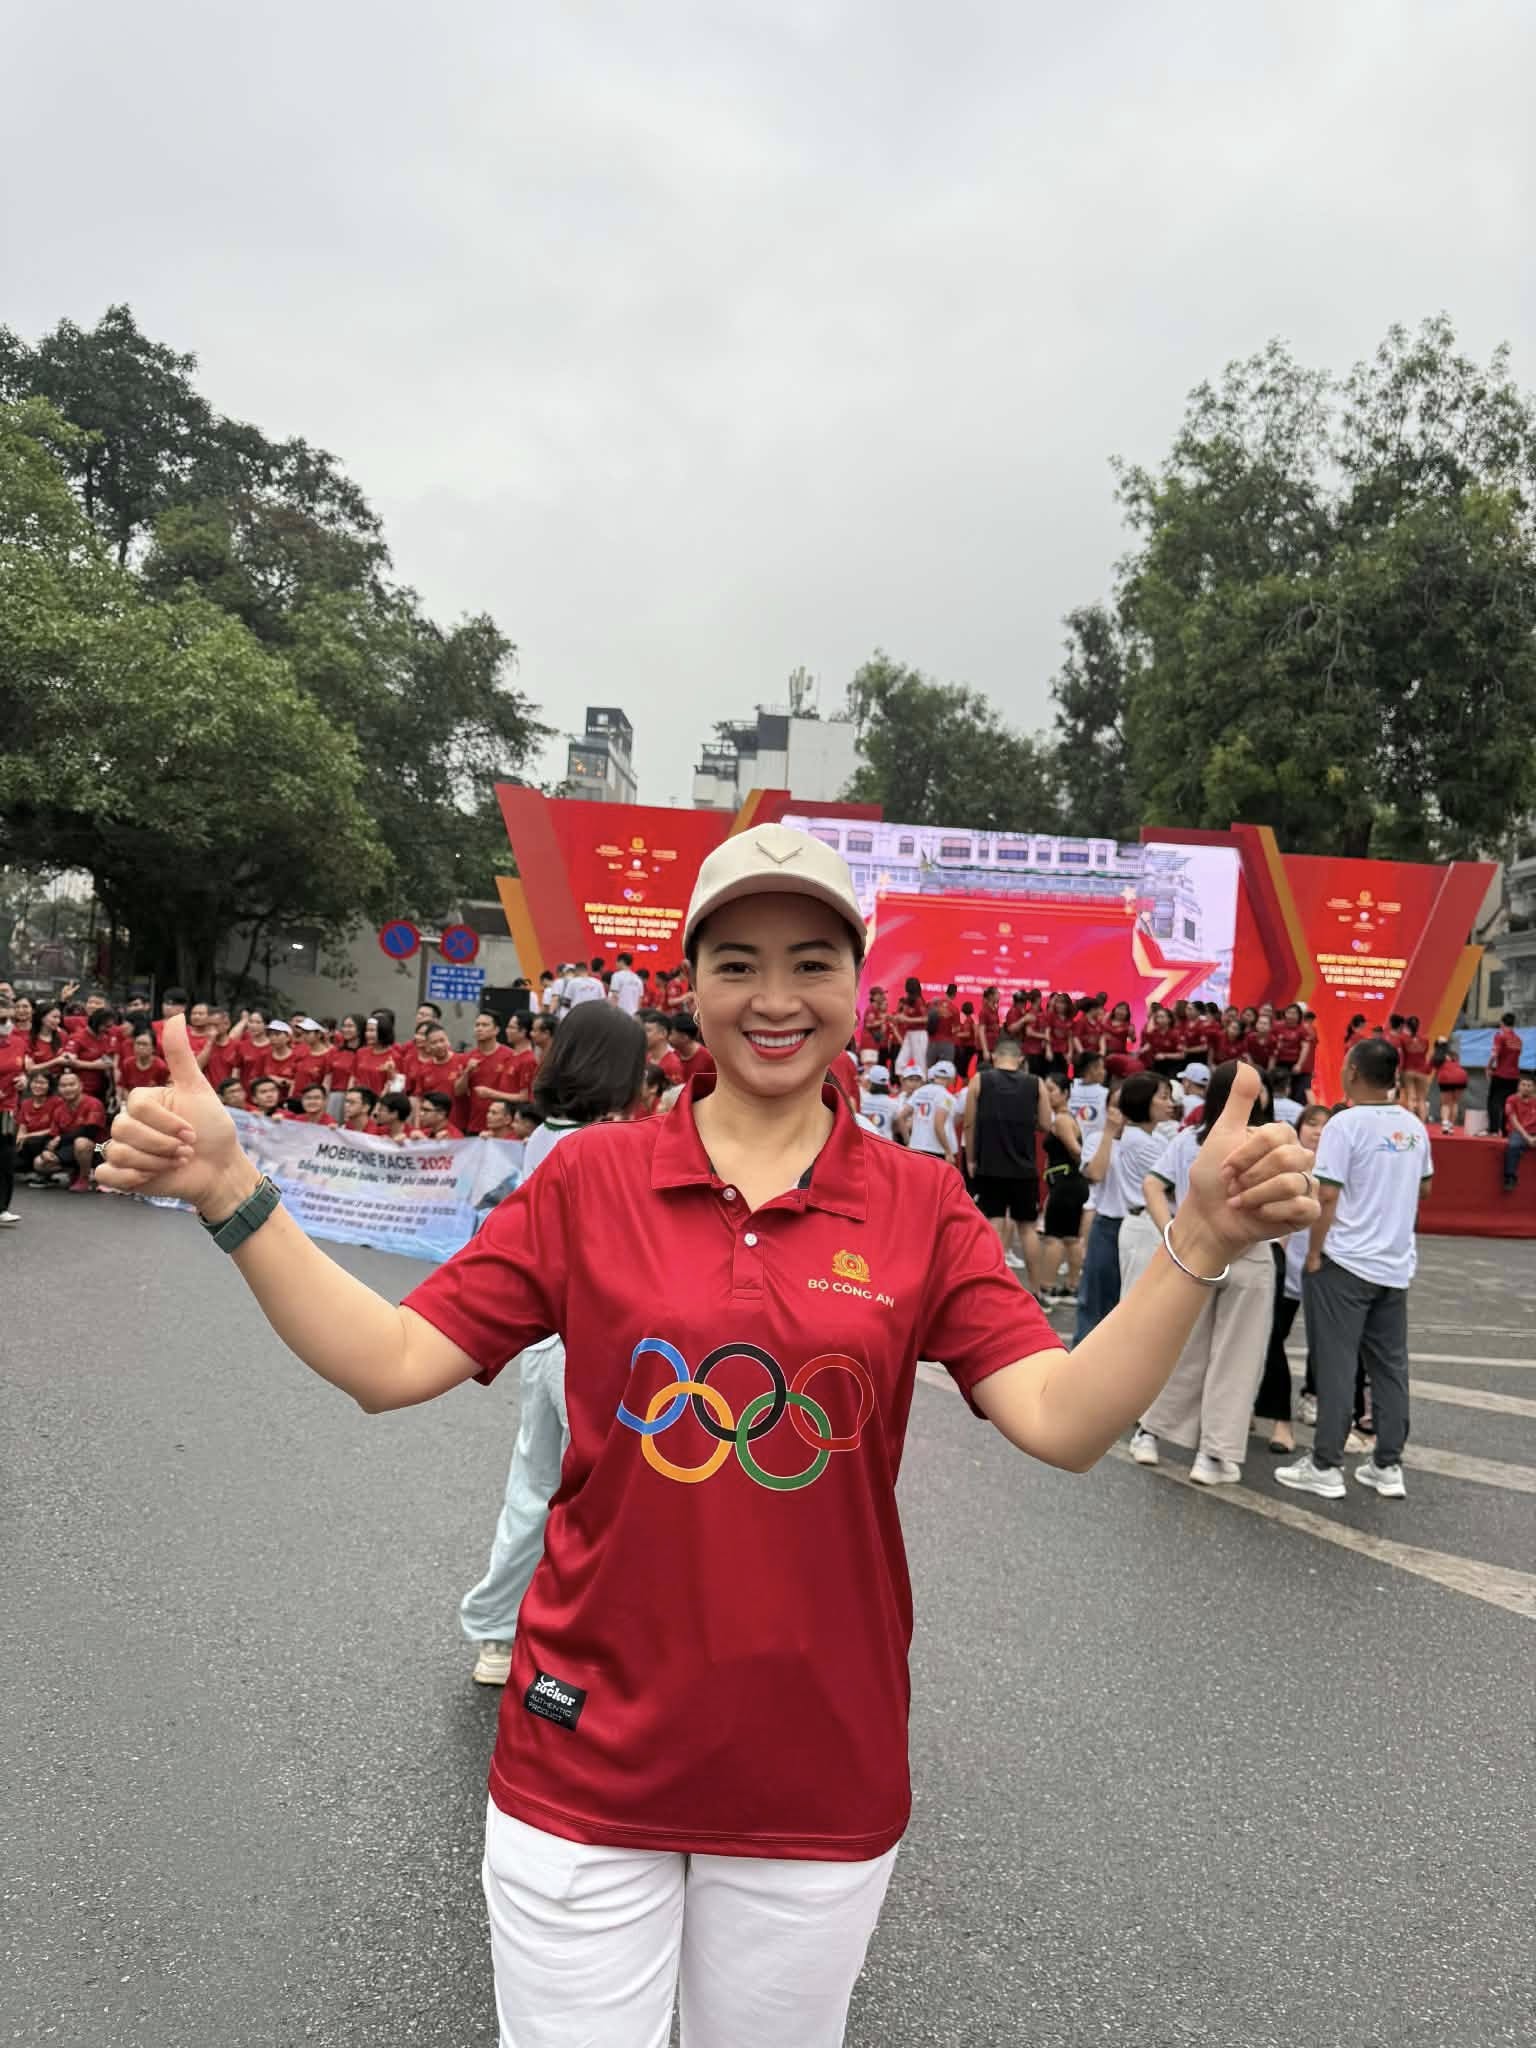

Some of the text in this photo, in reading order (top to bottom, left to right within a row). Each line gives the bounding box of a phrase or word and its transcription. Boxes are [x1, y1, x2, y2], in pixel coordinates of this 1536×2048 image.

[315, 1143, 377, 1167] MOBIFONE
[379, 1153, 417, 1171] RACE
[807, 1277, 895, 1308] BỘ CÔNG AN
[528, 1701, 563, 1722] PRODUCT
[529, 1693, 573, 1717] AUTHENTIC
